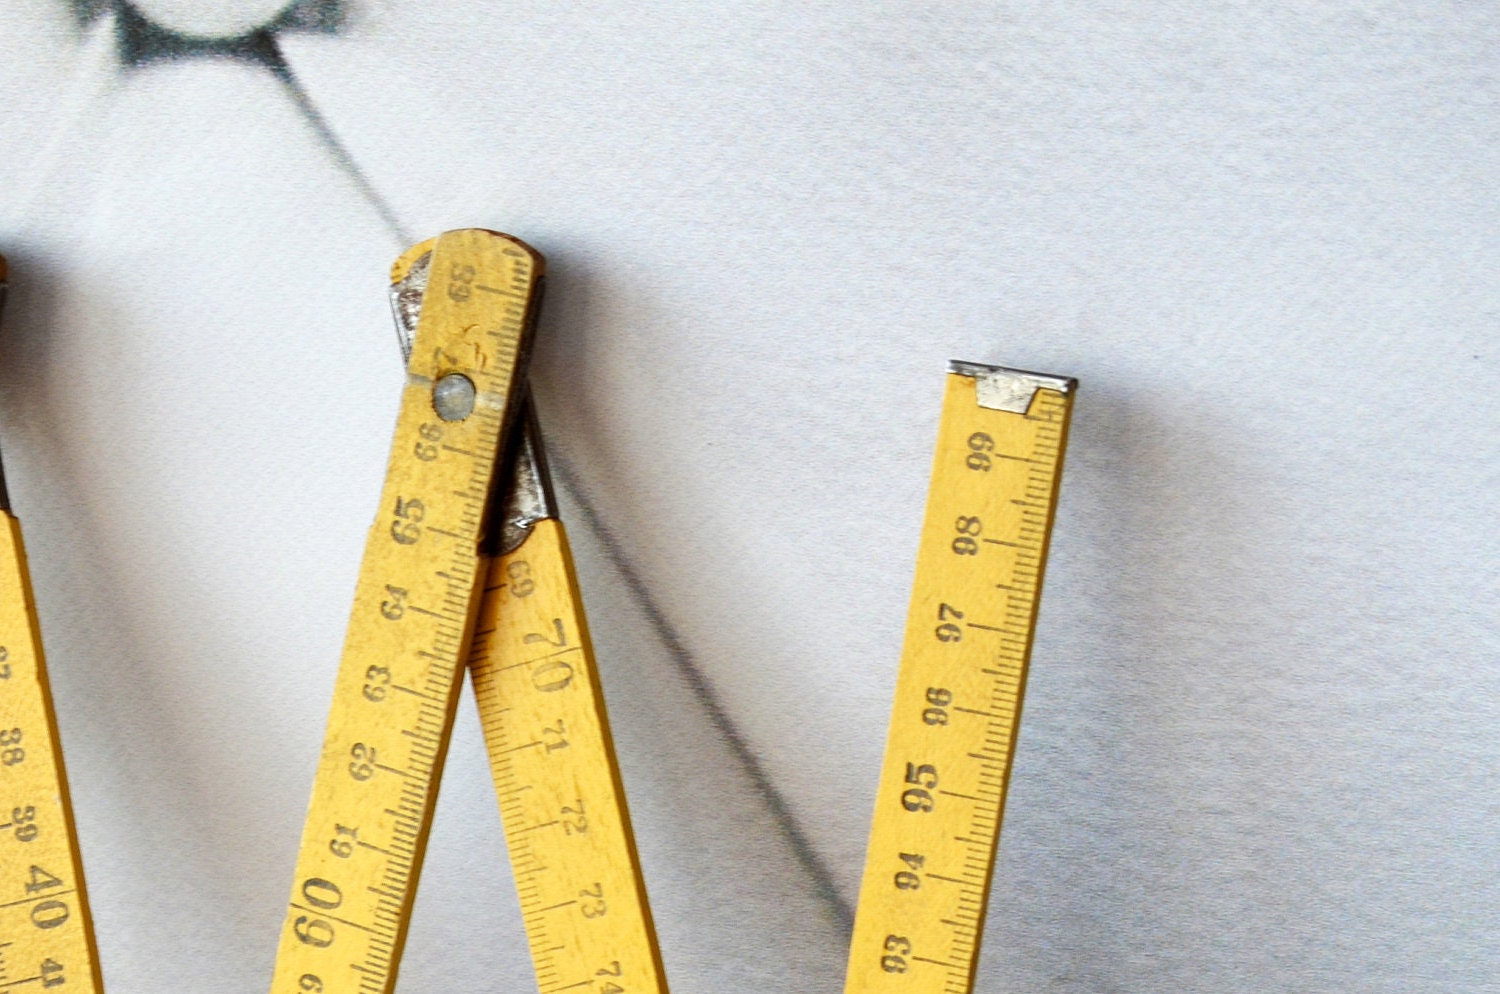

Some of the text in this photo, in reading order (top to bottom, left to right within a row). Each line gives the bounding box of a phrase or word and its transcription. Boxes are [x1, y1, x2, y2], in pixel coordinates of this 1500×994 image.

[446, 261, 476, 304] 68
[412, 421, 444, 462] 66
[964, 430, 995, 473] 99
[388, 494, 425, 545] 65
[949, 514, 982, 556] 98
[502, 558, 533, 599] 69
[378, 582, 409, 621] 64
[933, 601, 964, 643] 97
[520, 616, 575, 693] 70
[360, 663, 391, 702] 63
[920, 685, 952, 726] 96
[541, 717, 570, 755] 71
[347, 740, 377, 782] 62
[899, 760, 937, 813] 95
[10, 804, 39, 843] 39
[558, 796, 589, 837] 72
[327, 821, 359, 859] 61
[892, 851, 925, 891] 94
[23, 863, 70, 930] 40
[291, 876, 343, 948] 60
[577, 880, 607, 919] 73
[38, 956, 66, 989] 41
[878, 932, 911, 974] 93
